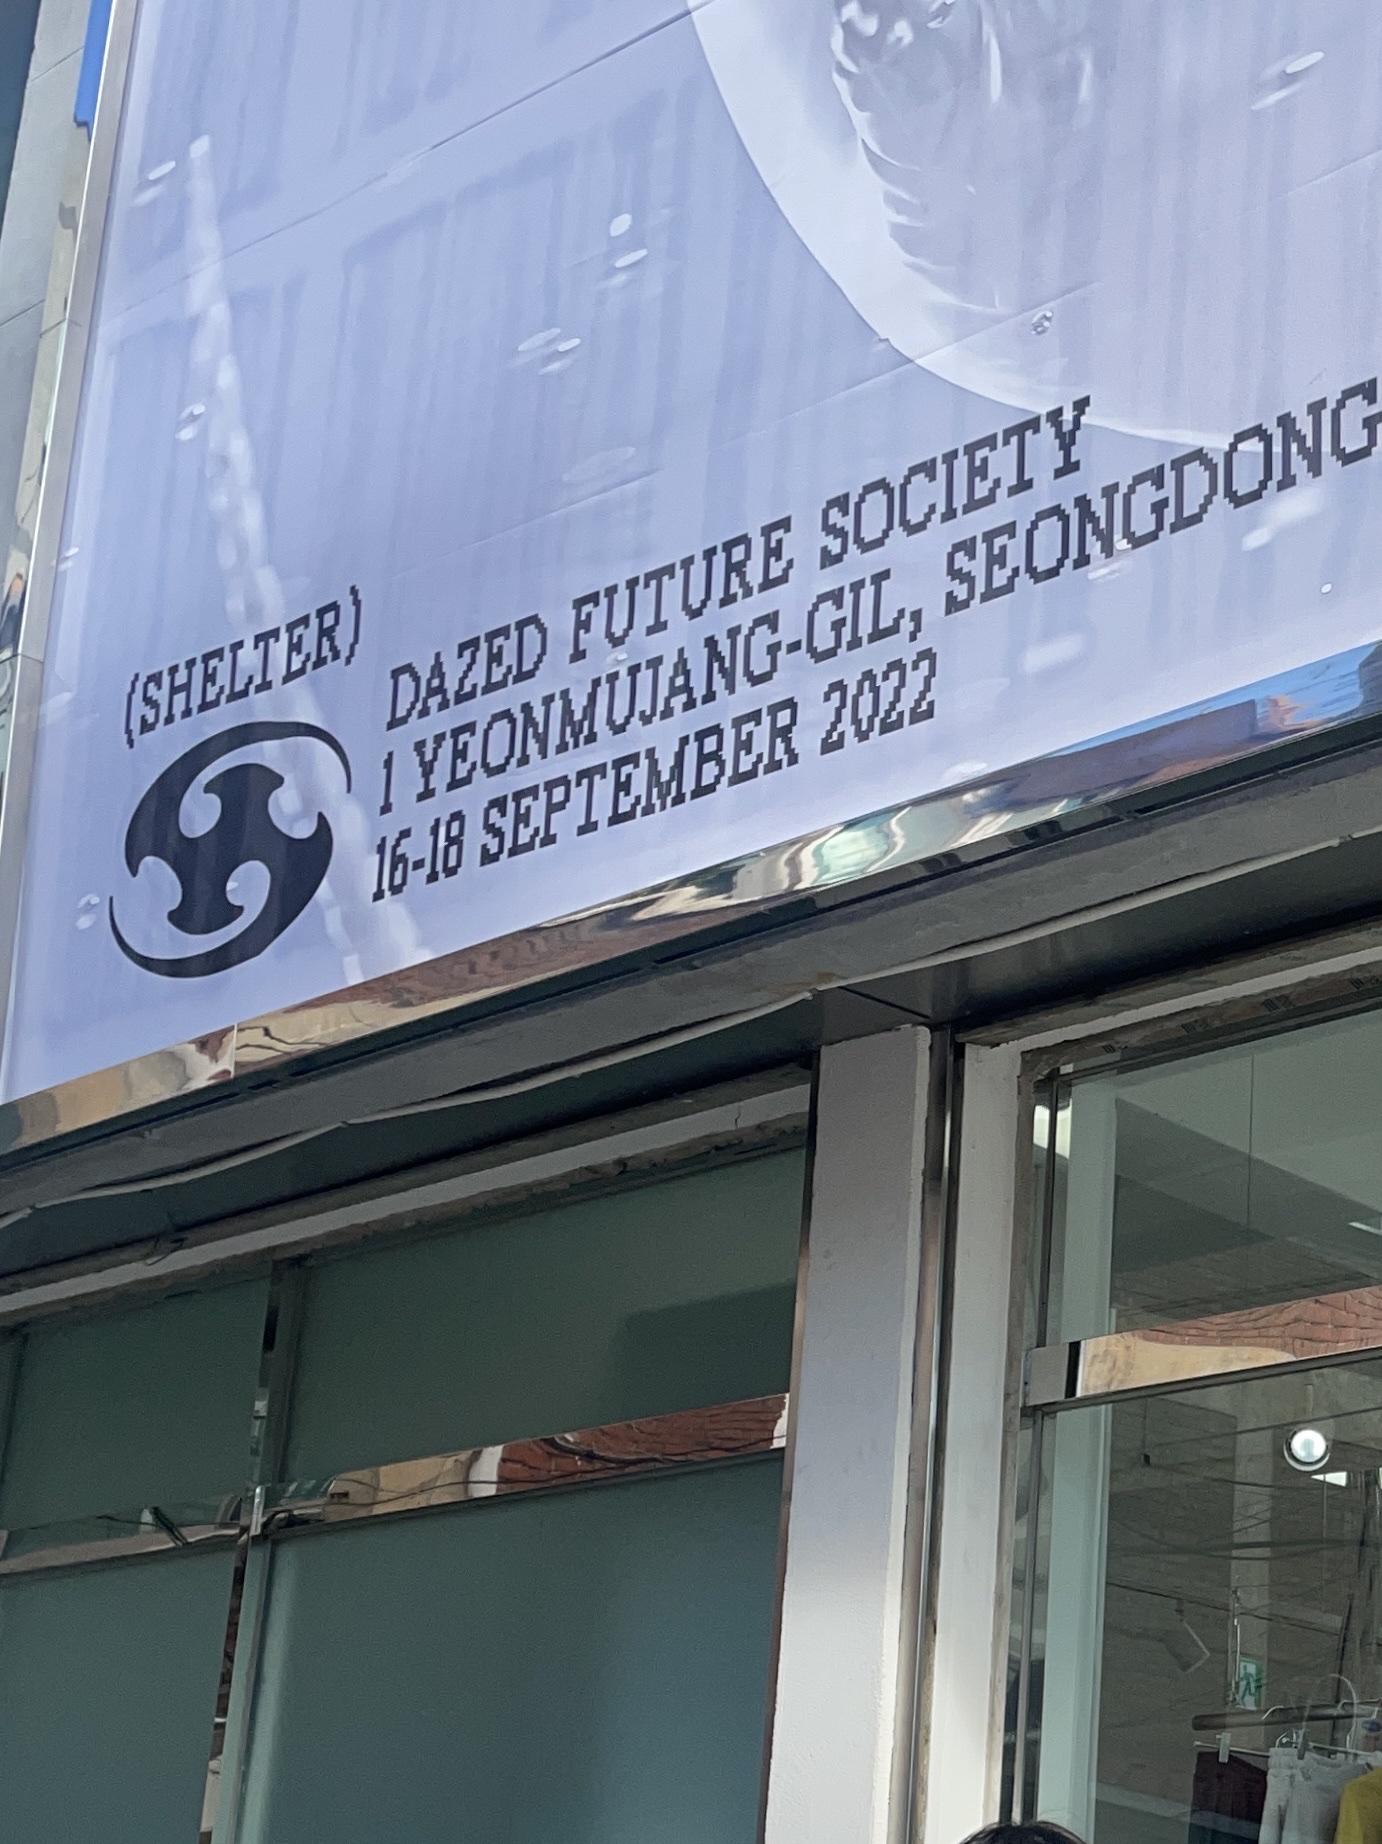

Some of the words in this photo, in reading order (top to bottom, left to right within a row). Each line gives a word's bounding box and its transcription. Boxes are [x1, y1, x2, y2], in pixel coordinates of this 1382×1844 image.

[124, 585, 362, 750] (SHELTER)
[385, 613, 548, 732] DAZED
[568, 515, 794, 665] FUTURE
[819, 394, 1091, 571] SOCIETY
[371, 809, 467, 903] 16-18
[479, 696, 799, 868] SEPTEMBER
[820, 647, 937, 756] 2022
[379, 750, 394, 817] 1
[413, 567, 923, 804] YEONMUJANG-GIL,
